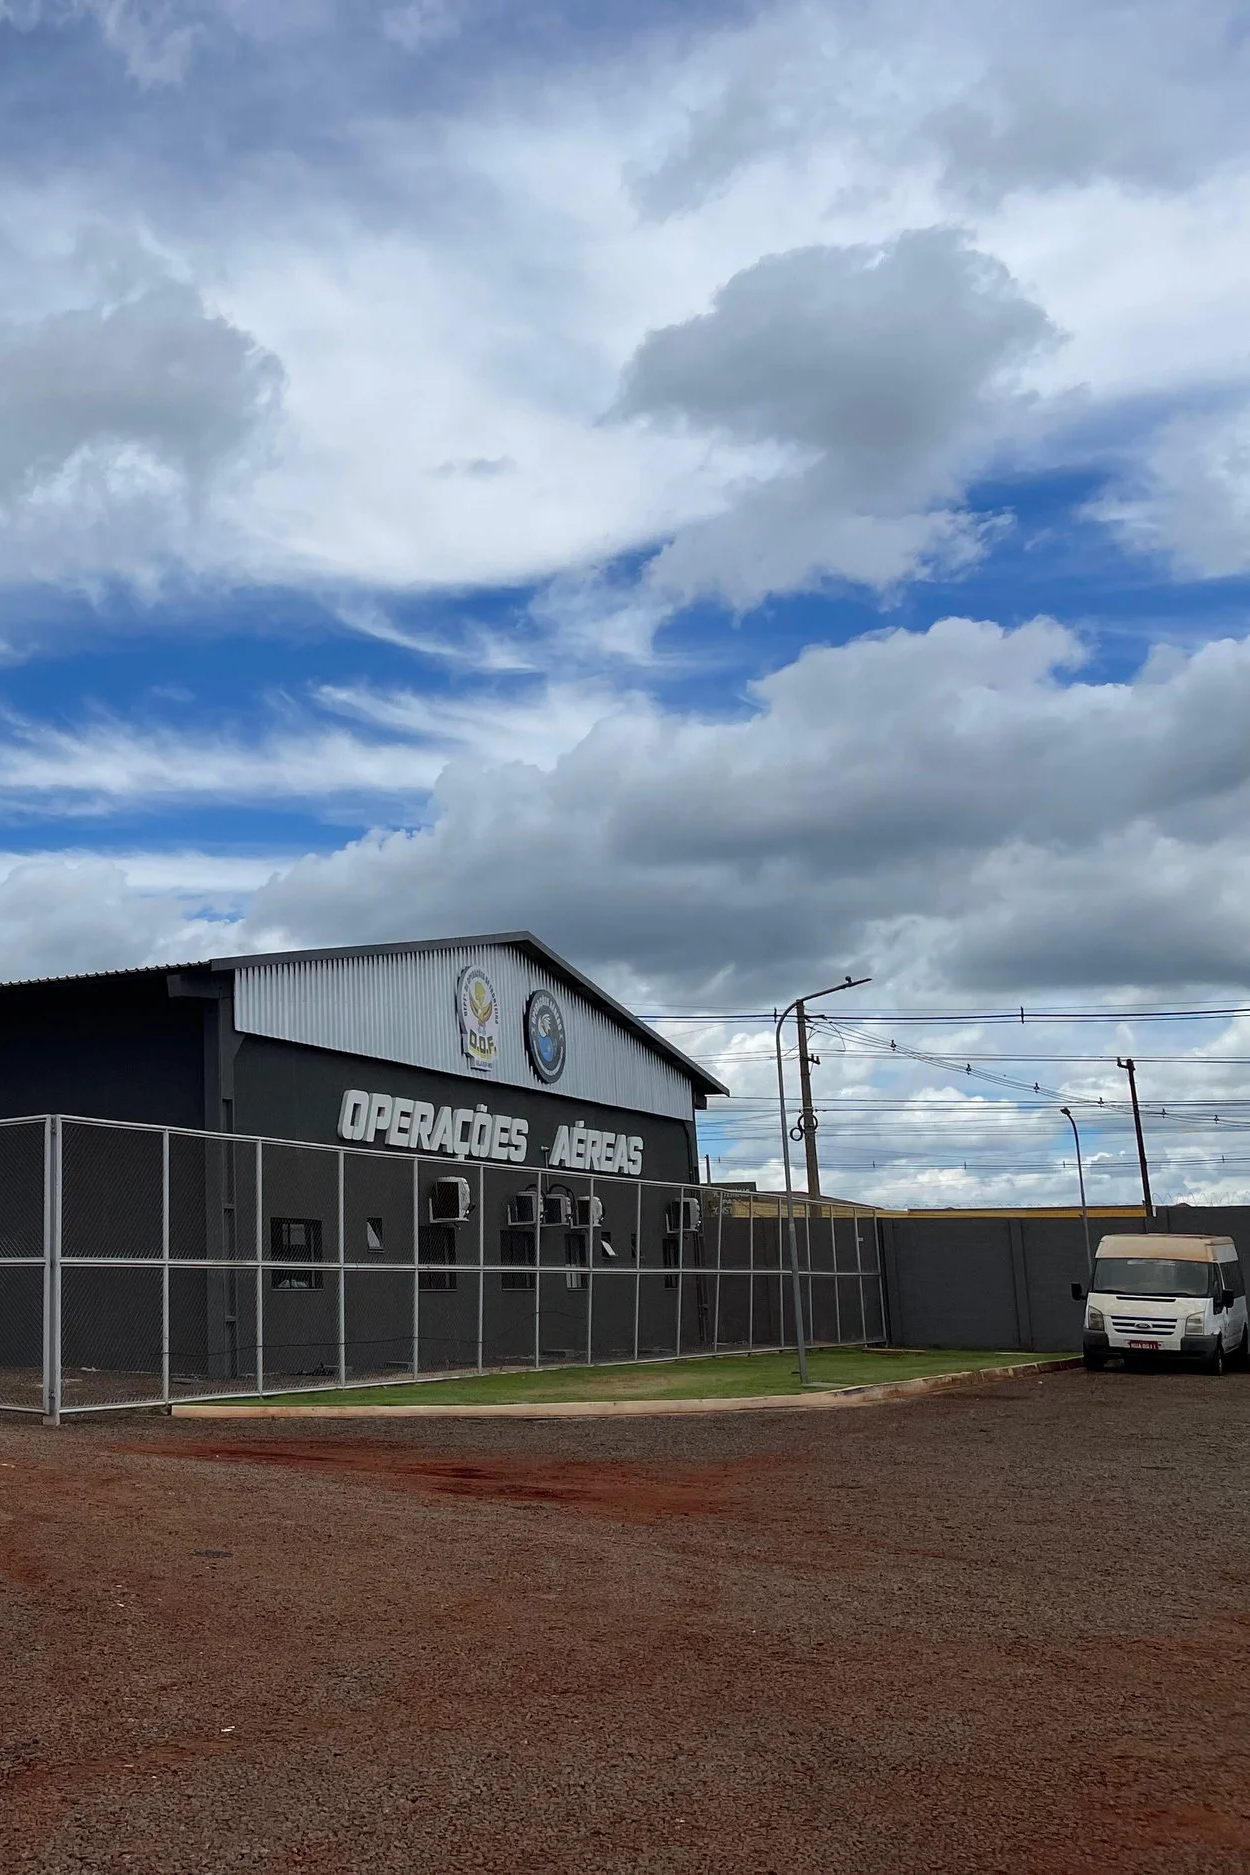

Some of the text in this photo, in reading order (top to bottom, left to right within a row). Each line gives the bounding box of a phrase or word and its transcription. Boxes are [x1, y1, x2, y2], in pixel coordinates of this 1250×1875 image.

[470, 1028, 497, 1054] D.O.F.
[338, 1089, 644, 1176] OPERAÇÕES AÉREAS
